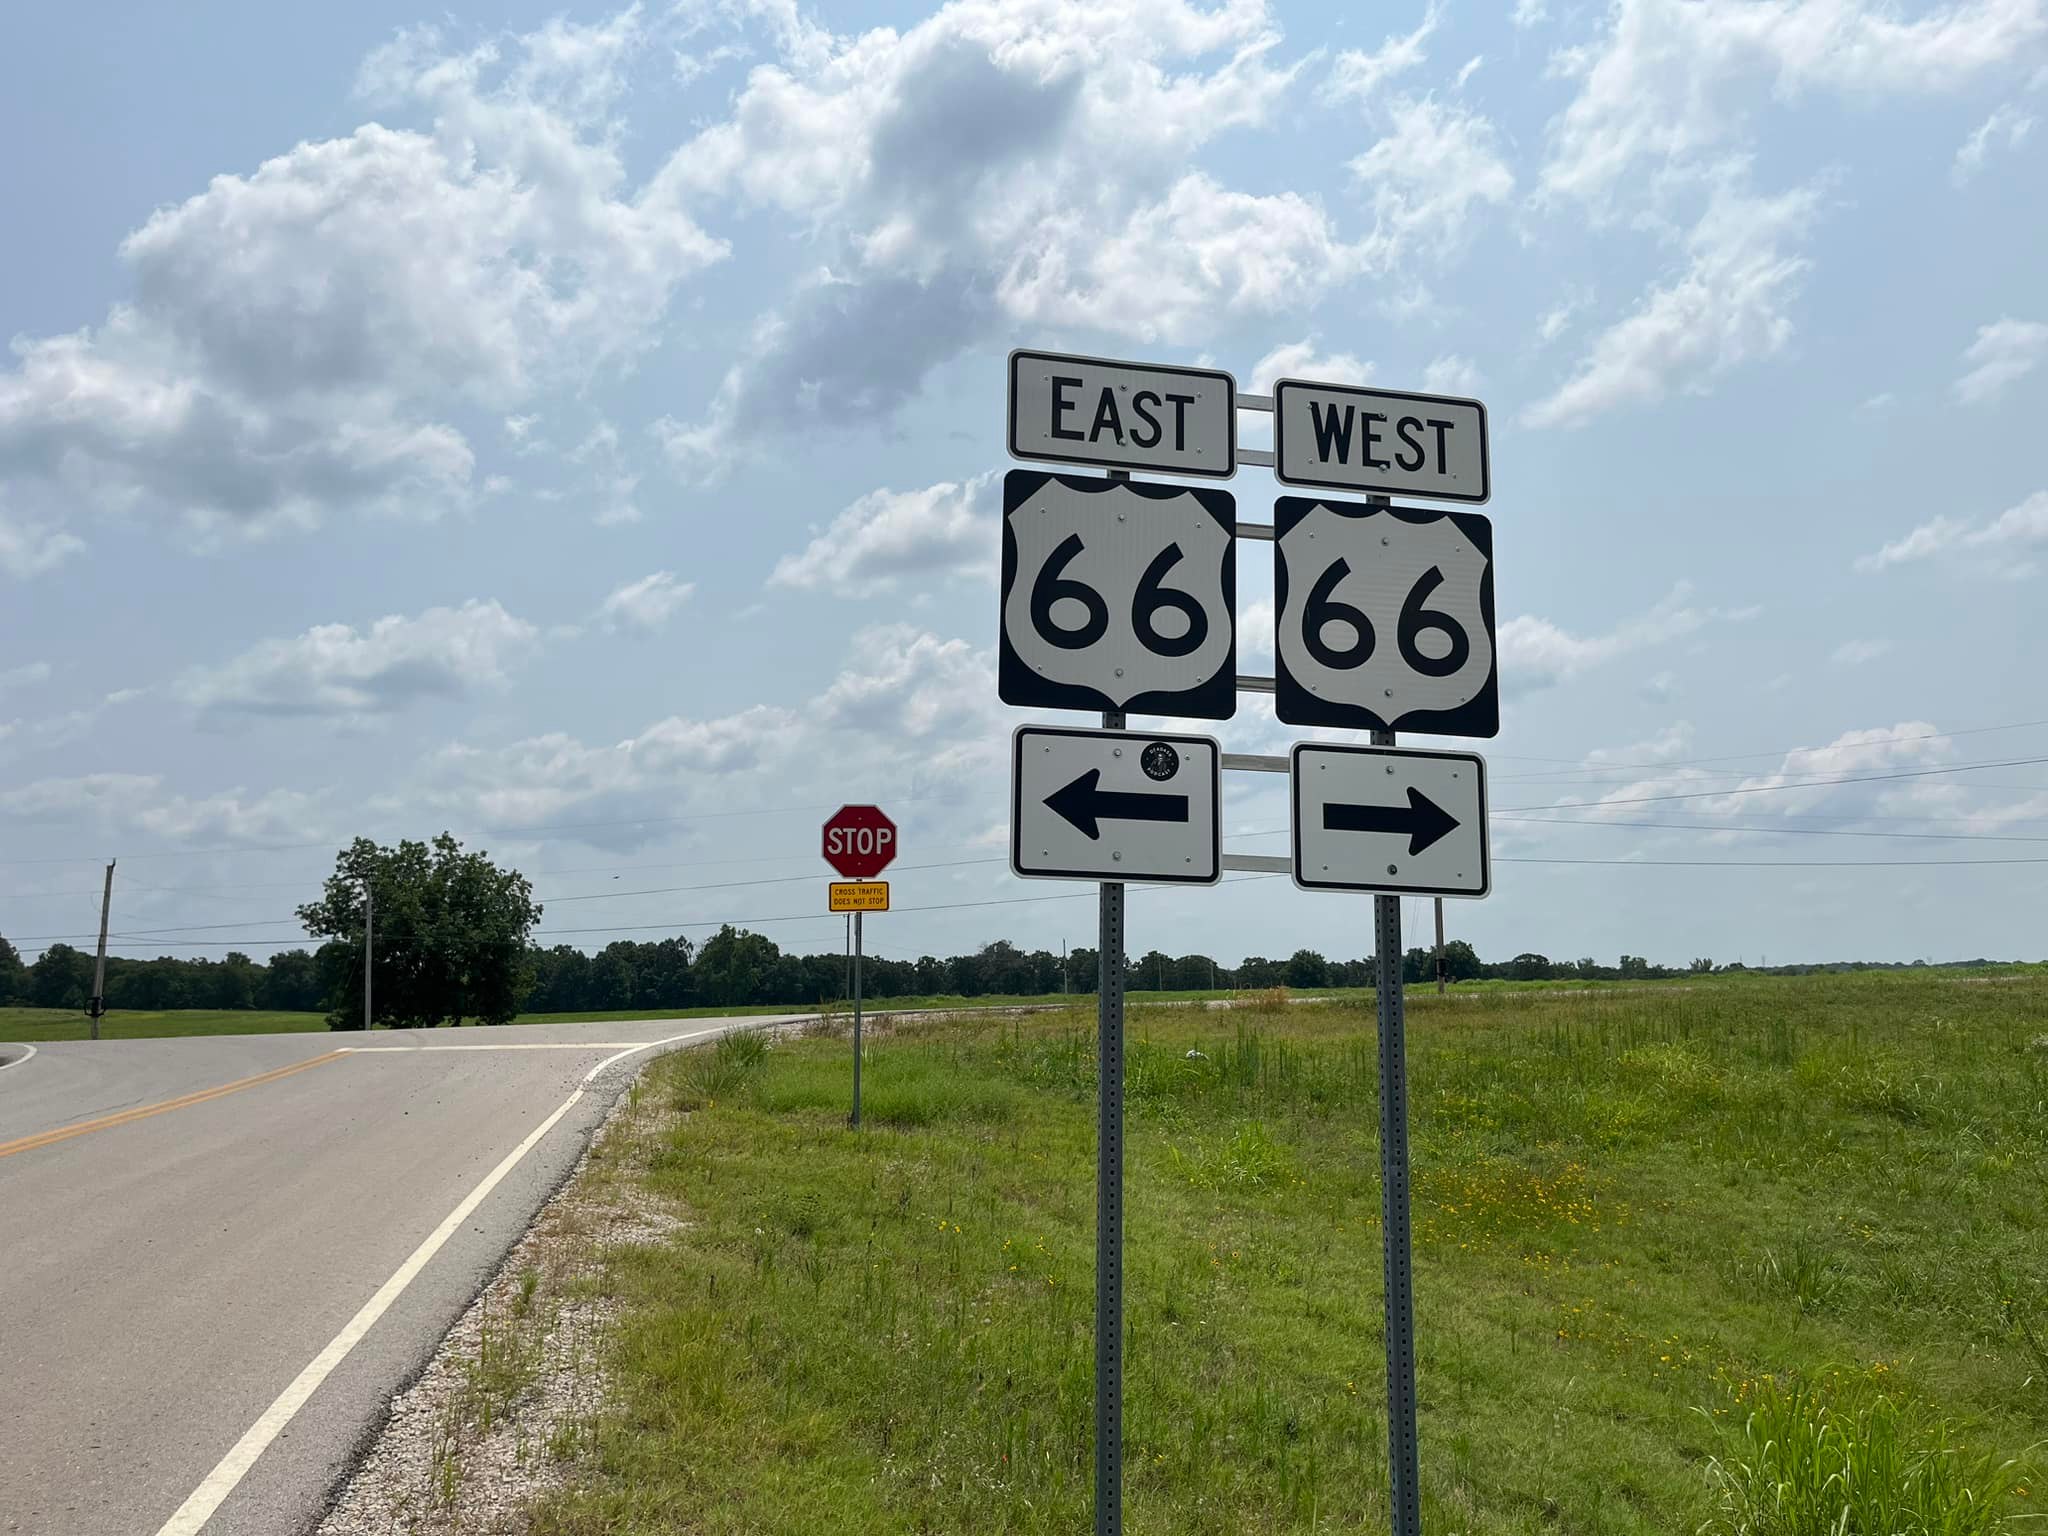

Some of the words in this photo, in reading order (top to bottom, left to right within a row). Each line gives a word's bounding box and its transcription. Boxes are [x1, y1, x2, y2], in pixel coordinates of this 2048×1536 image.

[1050, 375, 1195, 452] EAST
[1309, 400, 1454, 475] WEST
[1030, 533, 1208, 657] 66
[1302, 556, 1469, 677] 66
[827, 827, 892, 855] STOP
[833, 897, 851, 906] DOES
[853, 897, 866, 906] NOT
[868, 896, 884, 905] STOP
[834, 887, 856, 896] CROSS
[858, 887, 883, 896] TRAFFIC
